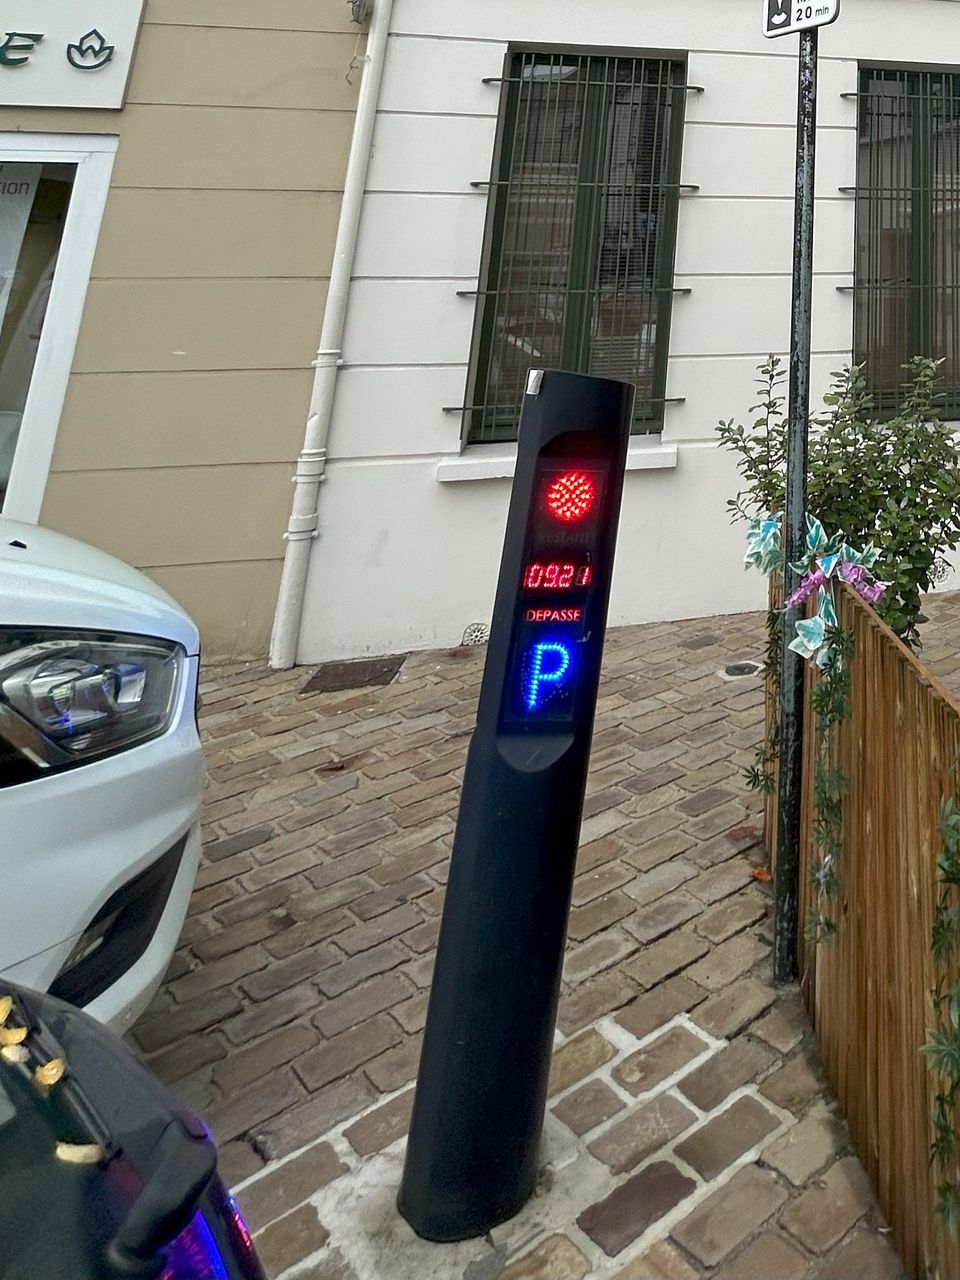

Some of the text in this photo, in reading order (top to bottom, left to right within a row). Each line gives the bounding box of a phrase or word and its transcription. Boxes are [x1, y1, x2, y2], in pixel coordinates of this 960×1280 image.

[796, 6, 829, 22] 20 min
[0, 181, 30, 196] ion
[527, 642, 570, 712] P
